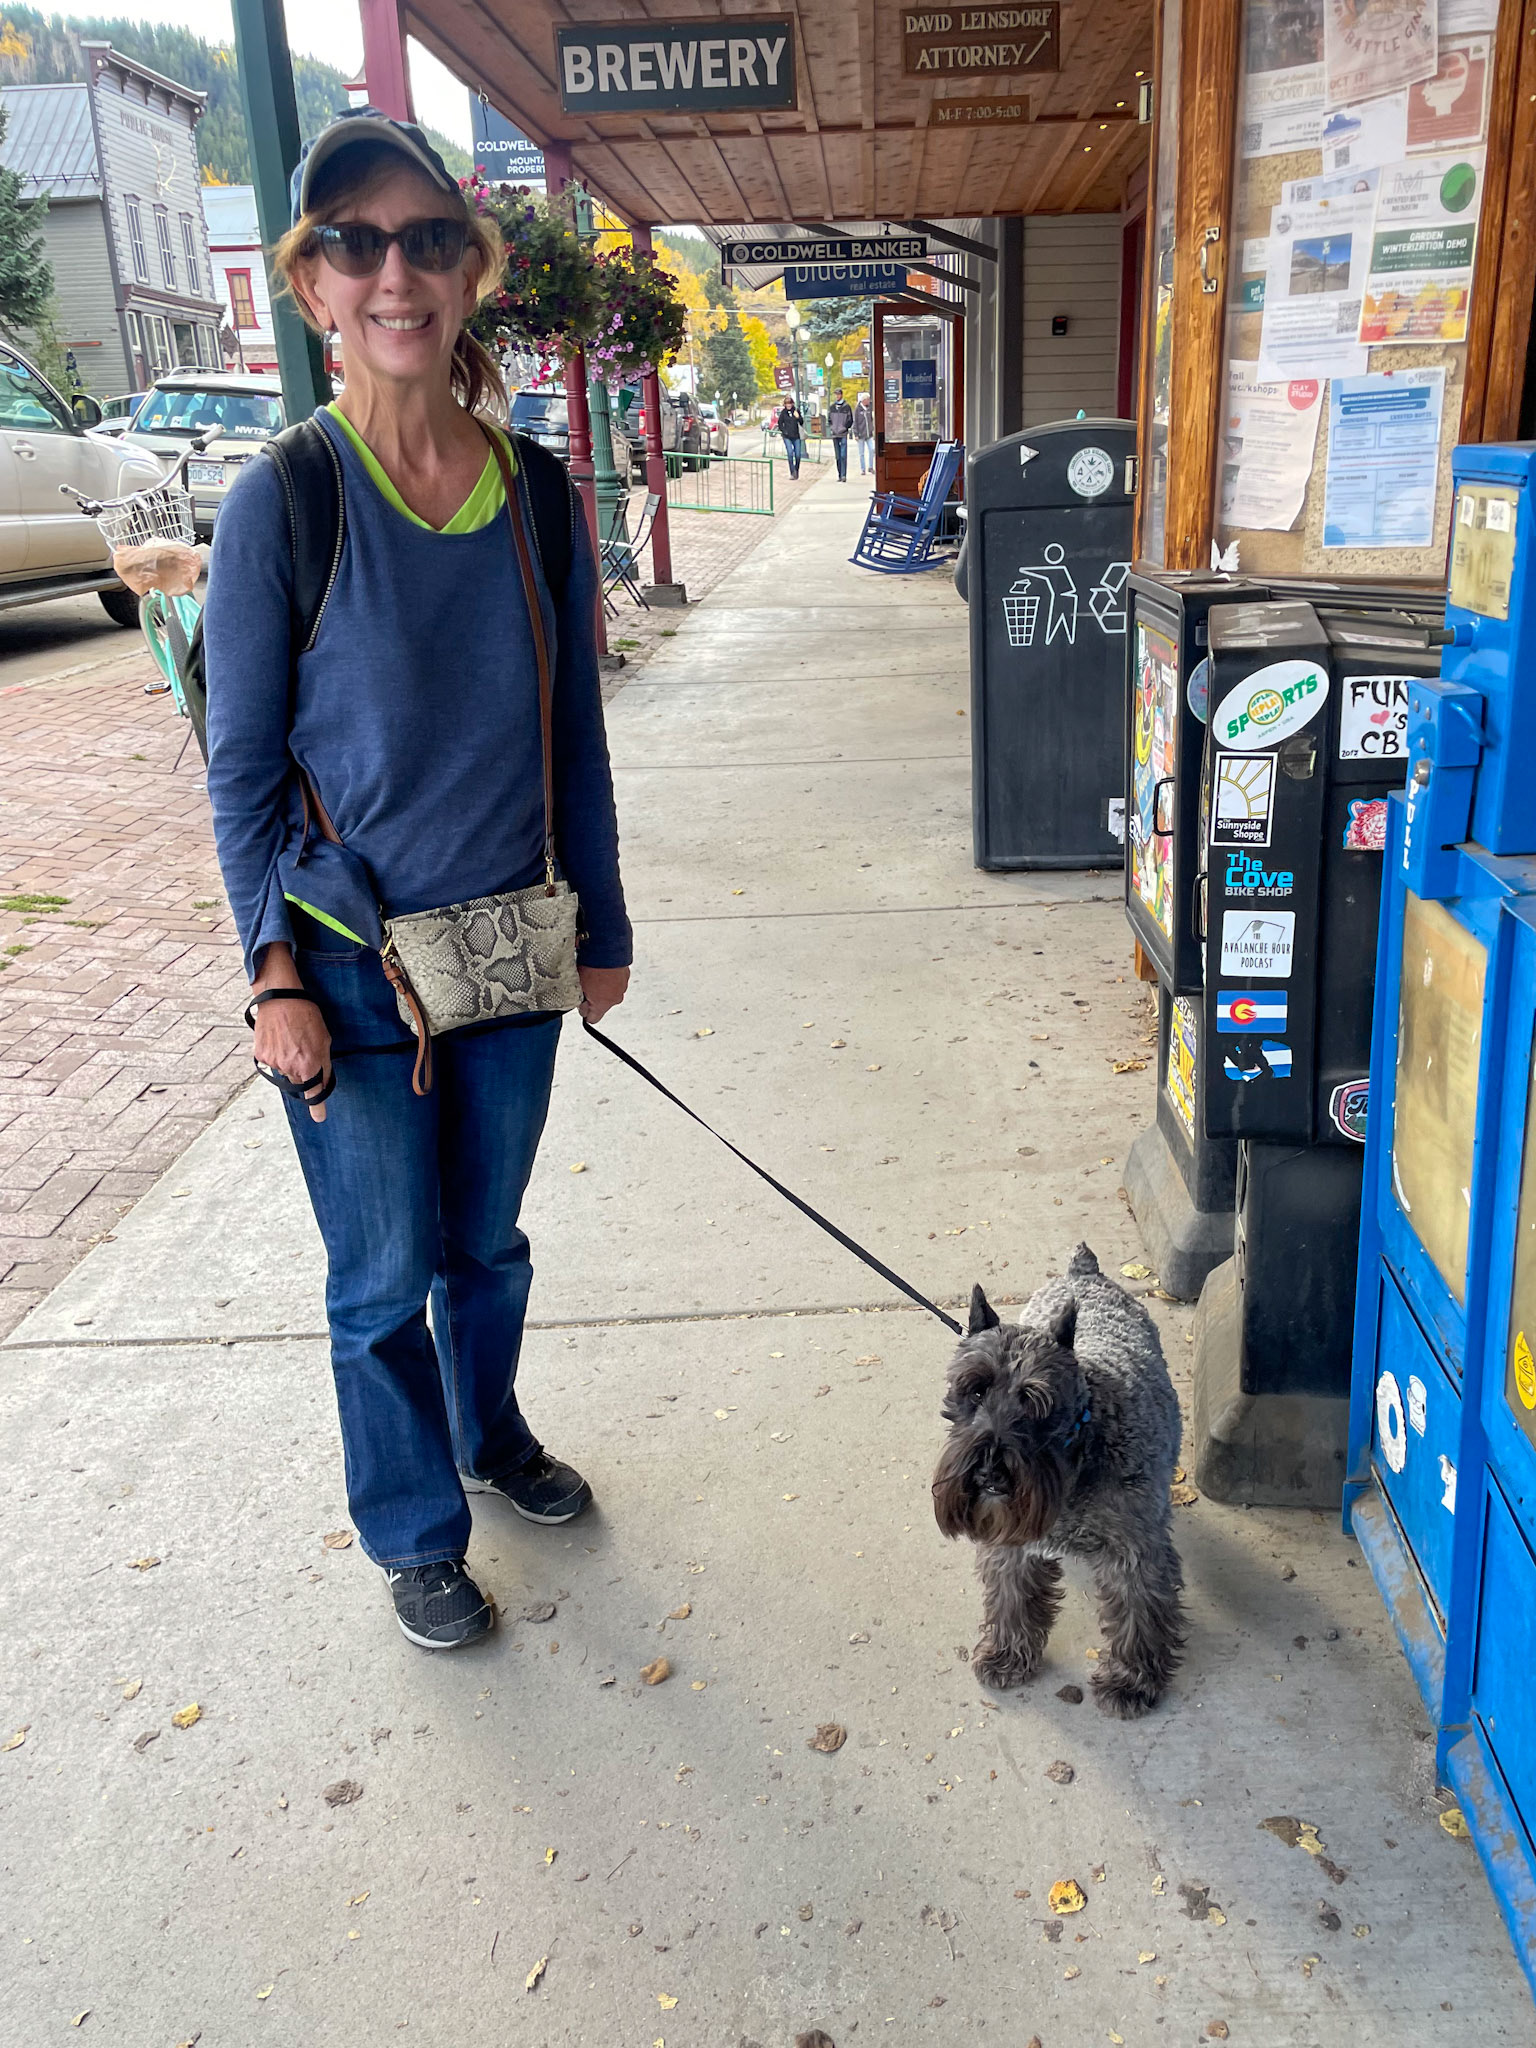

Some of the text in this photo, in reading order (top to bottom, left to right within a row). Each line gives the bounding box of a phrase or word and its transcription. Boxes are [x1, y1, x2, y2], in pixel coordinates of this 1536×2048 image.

[905, 9, 1052, 33] DAVID LEINSDORF
[915, 43, 1027, 70] ATTORNEY
[563, 37, 786, 94] BREWERY
[1409, 231, 1444, 241] GARDEN
[751, 240, 922, 261] COLDWELL BANKER
[1382, 238, 1467, 254] WINTERIZATION DEMO
[850, 279, 896, 291] real estate
[1361, 731, 1400, 755] CB
[1217, 820, 1261, 831] Sunnyside
[1233, 830, 1264, 840] Shoppe
[1226, 850, 1263, 871] The
[1226, 867, 1294, 888] Cove
[1225, 887, 1293, 897] BIKE SHOP
[1224, 942, 1291, 954] AVALANCHE HOUR
[1240, 956, 1273, 968] PODCAST
